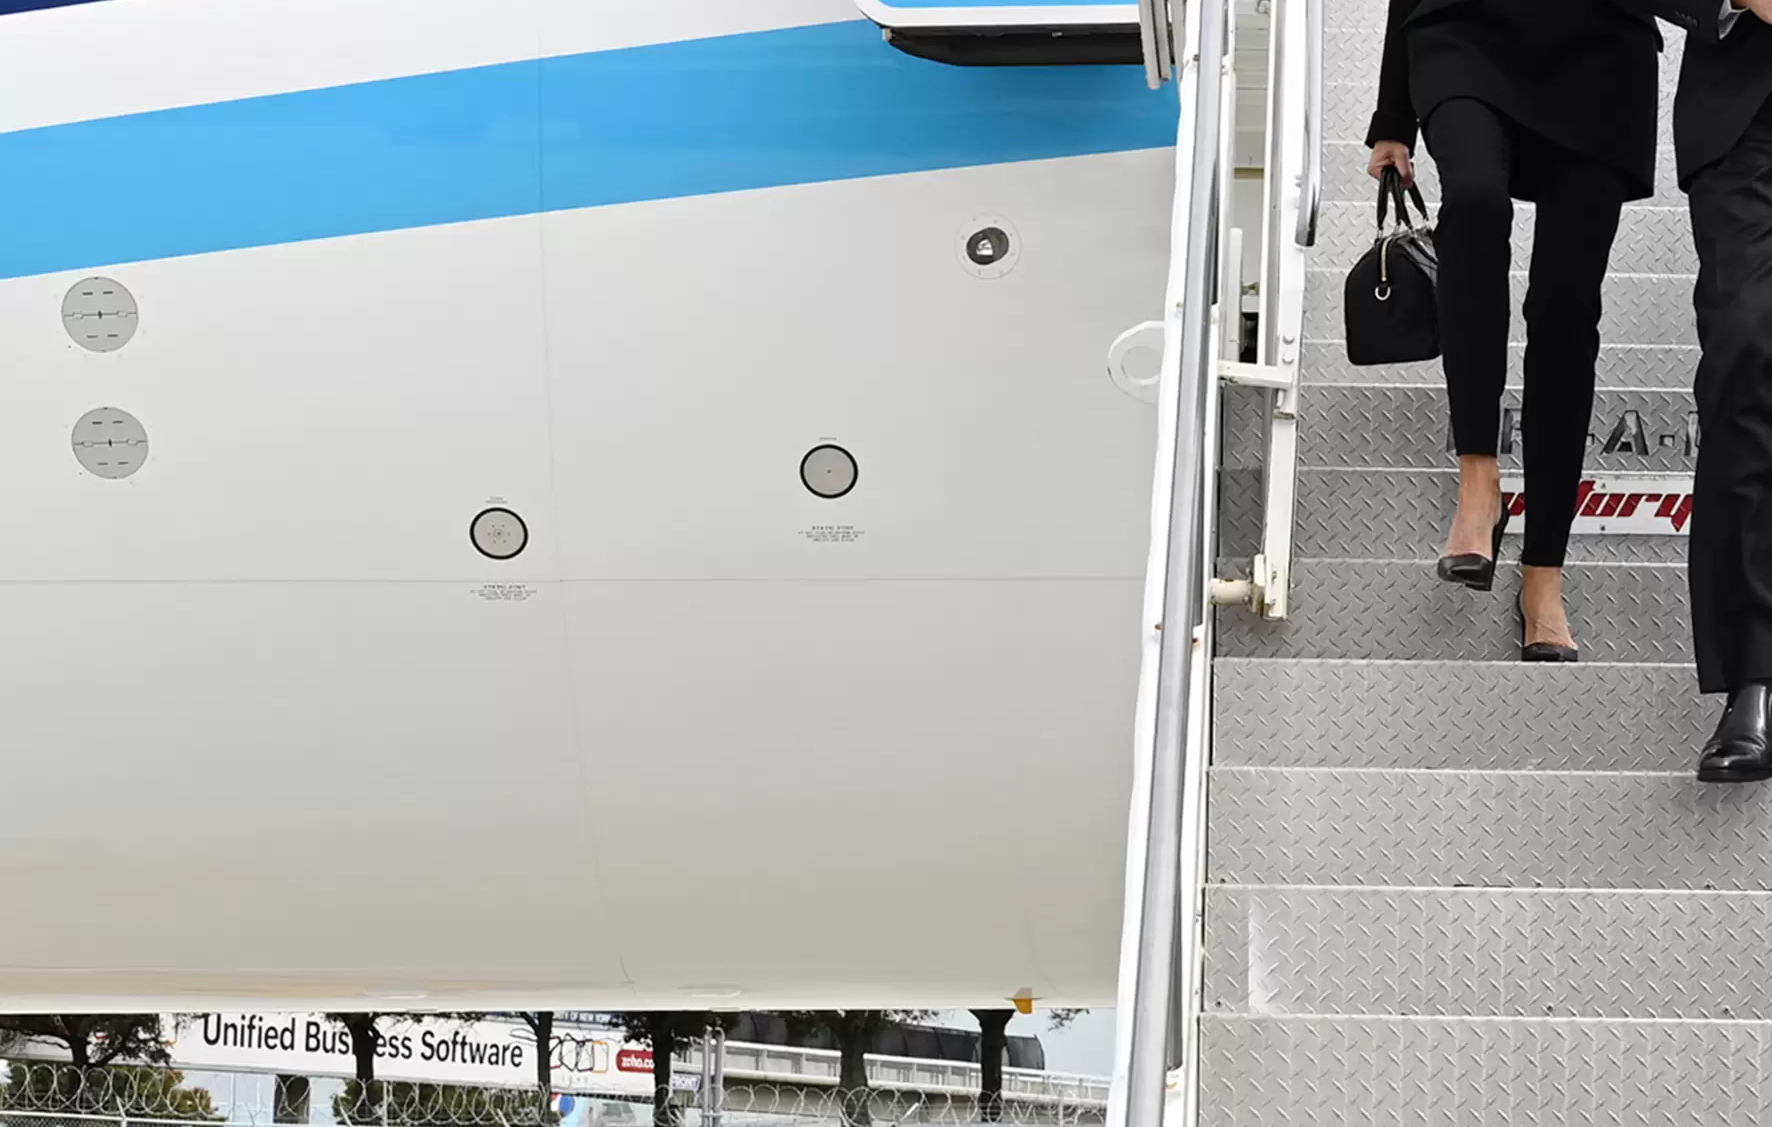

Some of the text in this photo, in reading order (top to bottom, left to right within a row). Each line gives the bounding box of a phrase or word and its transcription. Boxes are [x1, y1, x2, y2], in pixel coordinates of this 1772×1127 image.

[203, 1012, 523, 1068] Unified Busess Software
[621, 1053, 655, 1069] zoho.co
